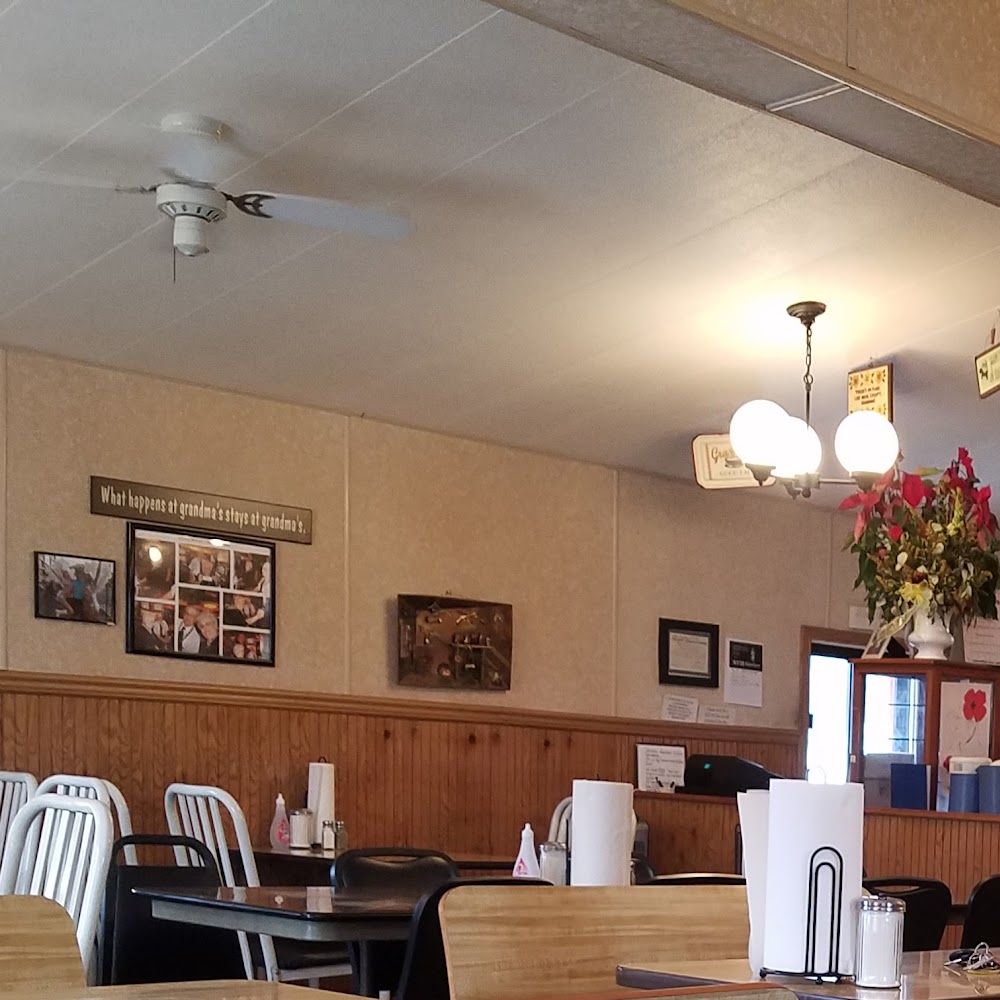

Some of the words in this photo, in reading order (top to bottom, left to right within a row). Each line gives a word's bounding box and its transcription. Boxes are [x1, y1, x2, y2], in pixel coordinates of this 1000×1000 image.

[101, 485, 126, 506] What
[128, 489, 166, 515] happens
[168, 501, 178, 514] at
[179, 500, 224, 521] grandma's
[225, 507, 249, 530] stays
[250, 512, 260, 526] at
[261, 511, 307, 534] grandma's.
